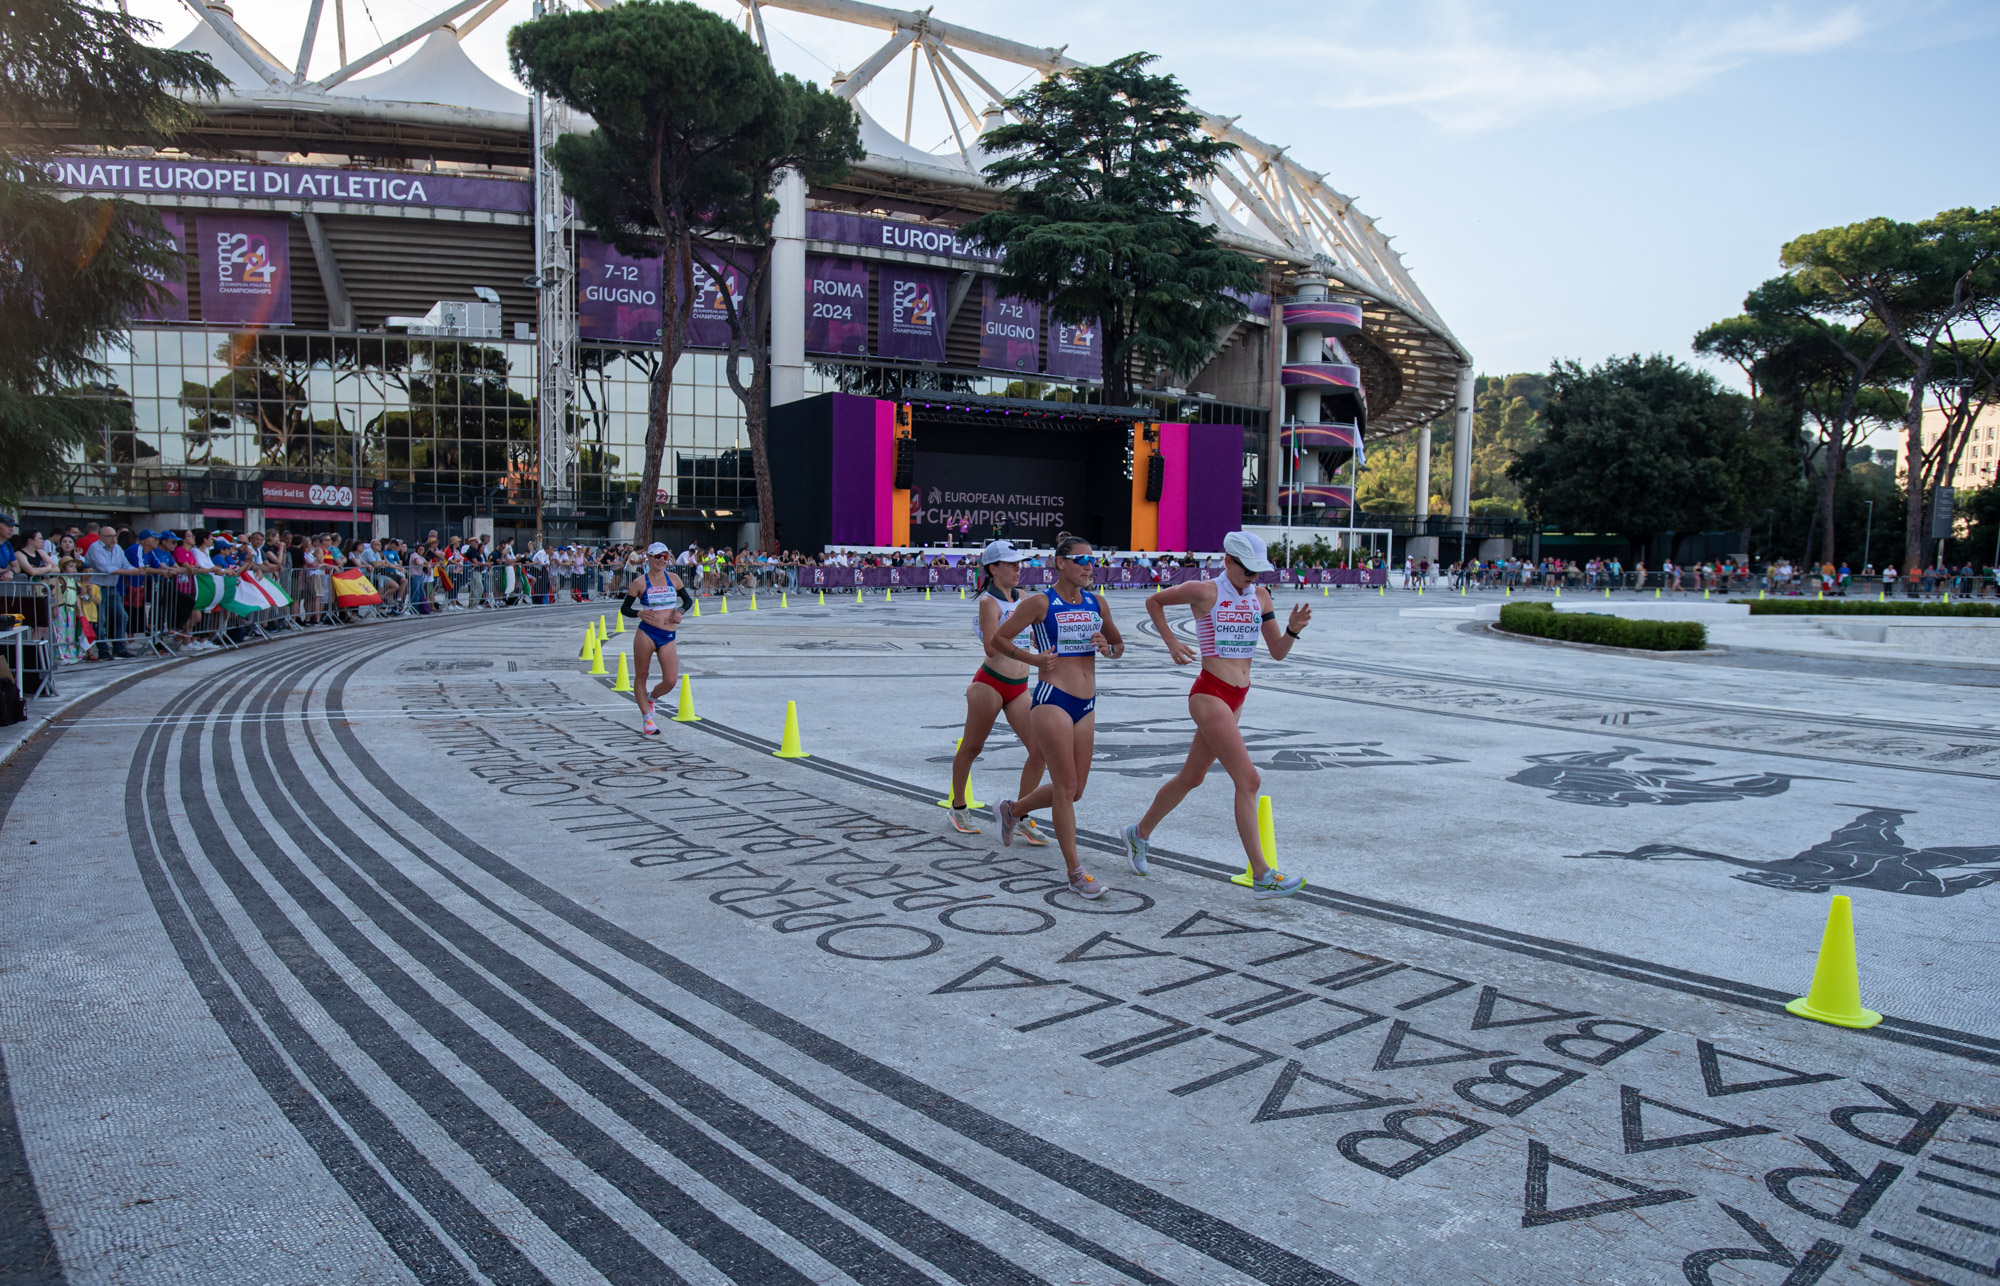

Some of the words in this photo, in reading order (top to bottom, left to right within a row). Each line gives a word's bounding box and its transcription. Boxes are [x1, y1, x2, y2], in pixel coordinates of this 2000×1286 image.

[17, 161, 130, 187] ONATI
[138, 166, 256, 193] EUROPEI
[263, 171, 290, 194] DI
[298, 173, 428, 202] ATLETICA
[604, 263, 639, 281] 7-12
[219, 287, 272, 295] CHAMPIONSHIPS
[585, 285, 656, 306] GIUGNO
[812, 303, 853, 321] 2024
[1000, 303, 1023, 319] 7-12
[985, 321, 1035, 340] GIUGNO
[263, 487, 283, 498] Distinti
[283, 488, 295, 498] Sud
[295, 490, 304, 499] Est
[311, 488, 322, 501] 22
[326, 489, 337, 502] 23
[340, 490, 351, 503] 24
[945, 491, 1005, 505] EUROPEAN
[1007, 494, 1064, 507] ATHLETICS
[1057, 613, 1091, 623] SPAR
[1217, 612, 1252, 623] SPAR
[1059, 623, 1101, 633] TSINOPOULOU
[1216, 624, 1259, 634] CHOJECKA
[626, 787, 837, 854] BALILLA
[533, 794, 733, 868] BALILLA
[786, 846, 1057, 936] OPERA
[669, 859, 945, 961] OPERA
[1160, 909, 1666, 1067] BALILLA
[1055, 930, 1588, 1118] BALILLA
[927, 954, 1494, 1181] BALILLA
